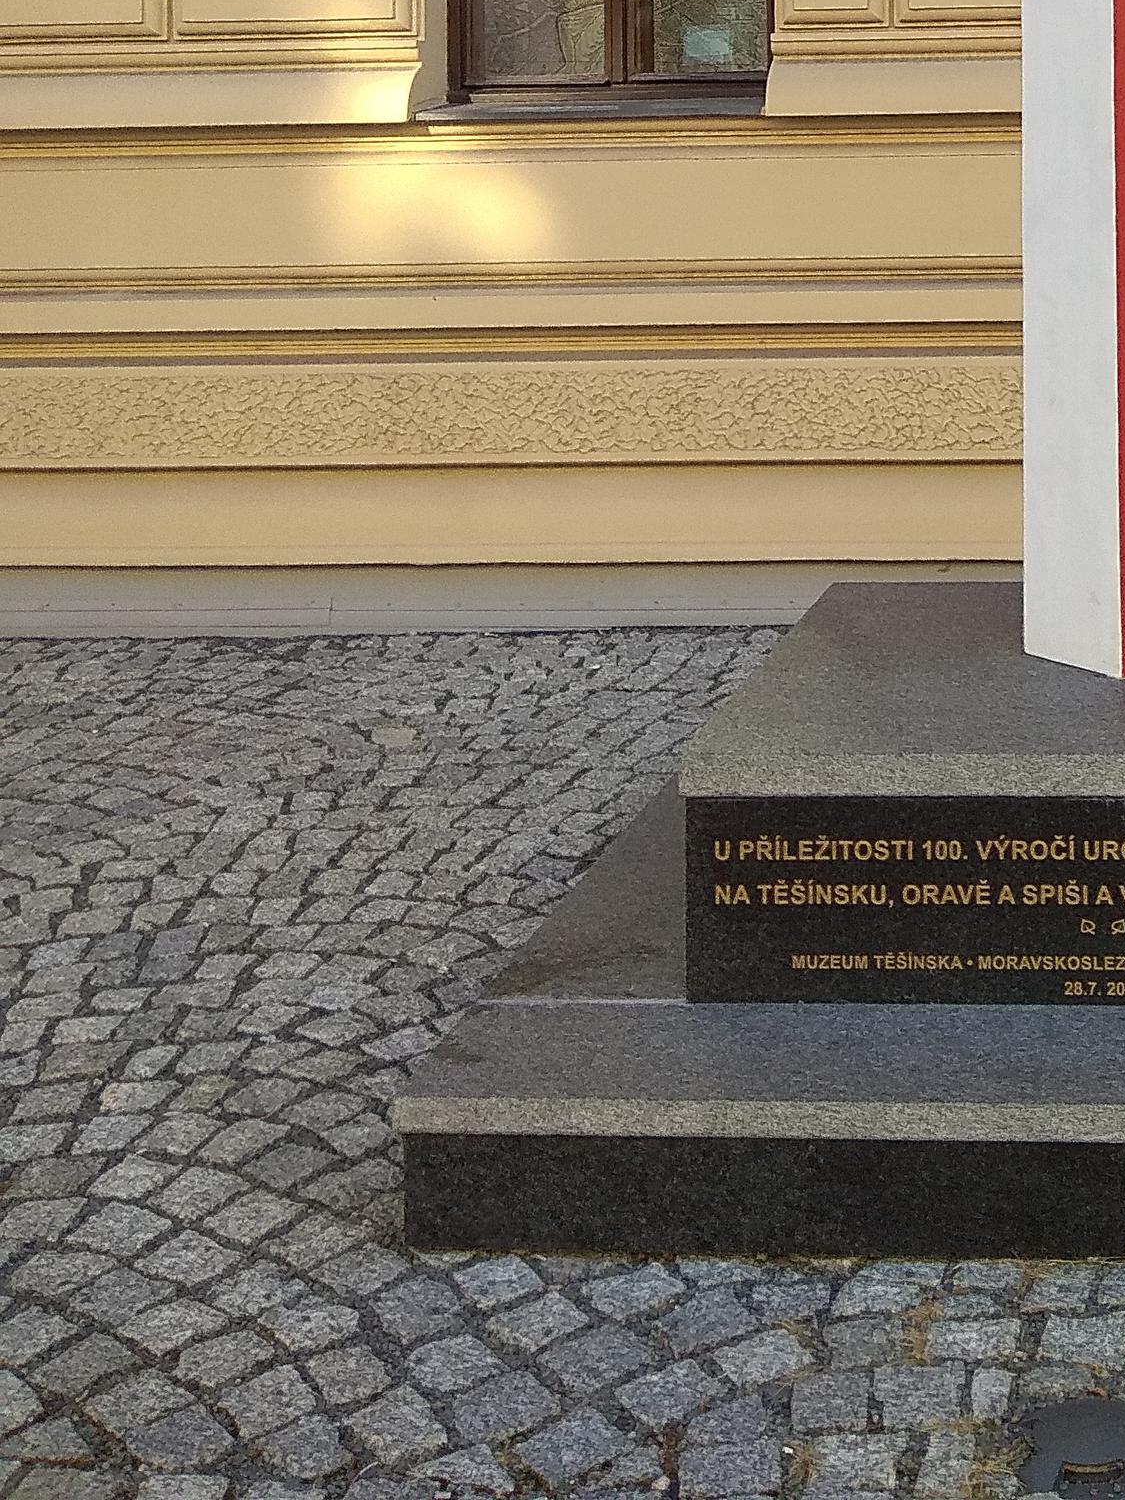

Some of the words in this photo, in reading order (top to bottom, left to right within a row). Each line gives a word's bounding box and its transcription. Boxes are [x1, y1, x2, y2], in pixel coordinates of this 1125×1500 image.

[714, 840, 731, 861] U
[739, 835, 914, 861] PŘÍLEŽITOSTI
[922, 840, 969, 861] 100.
[976, 835, 1075, 861] VÝROČÍ
[714, 884, 751, 905] NA
[757, 879, 894, 908] TĚŠÍNSKU,
[902, 879, 991, 905] ORAVĚ
[997, 884, 1016, 905] A
[1022, 879, 1089, 905] SPIŠI
[1095, 885, 1114, 905] A
[792, 954, 868, 970] MUZEUM
[873, 951, 963, 970] TĚŠÍNSKA
[1064, 981, 1101, 996] 28.7.
